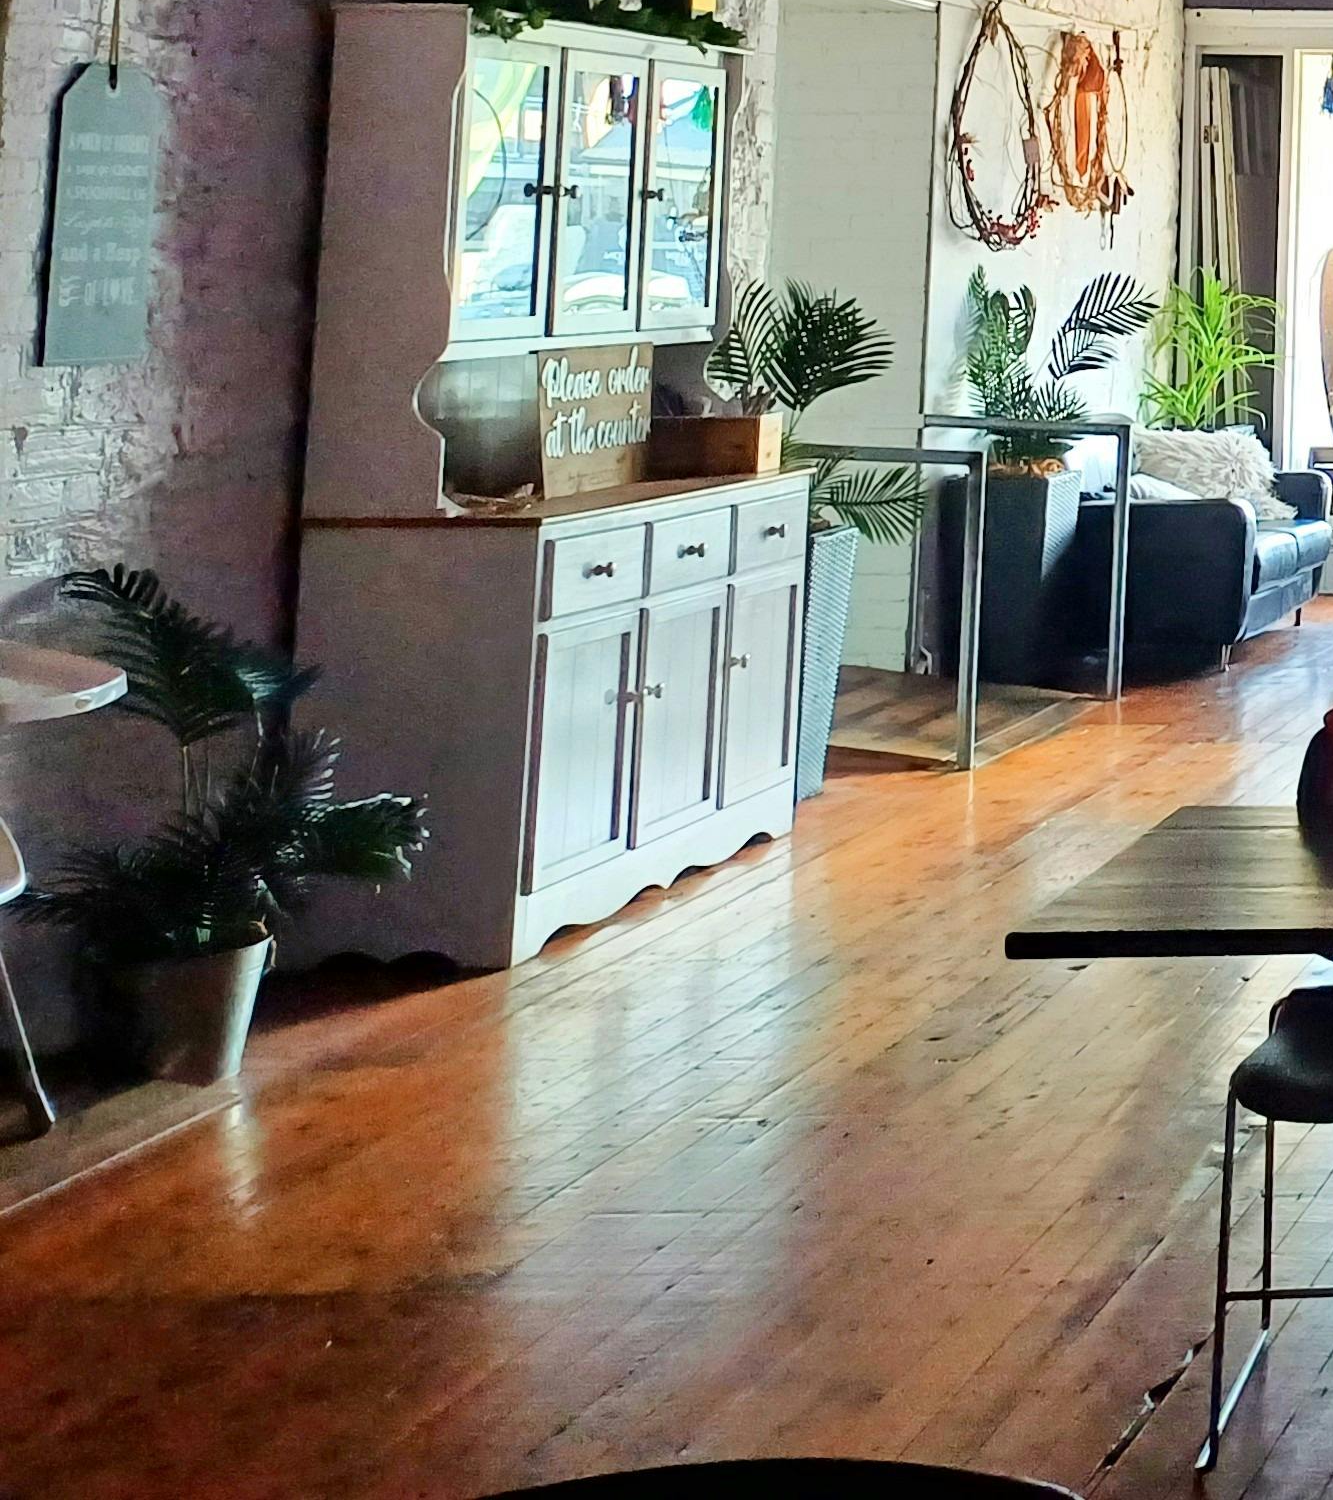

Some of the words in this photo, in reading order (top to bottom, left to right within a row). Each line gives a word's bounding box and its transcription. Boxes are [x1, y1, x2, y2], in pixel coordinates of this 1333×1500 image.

[542, 357, 600, 408] Please
[608, 346, 651, 394] order
[546, 411, 567, 457] at
[568, 406, 595, 454] the
[597, 399, 651, 448] counter
